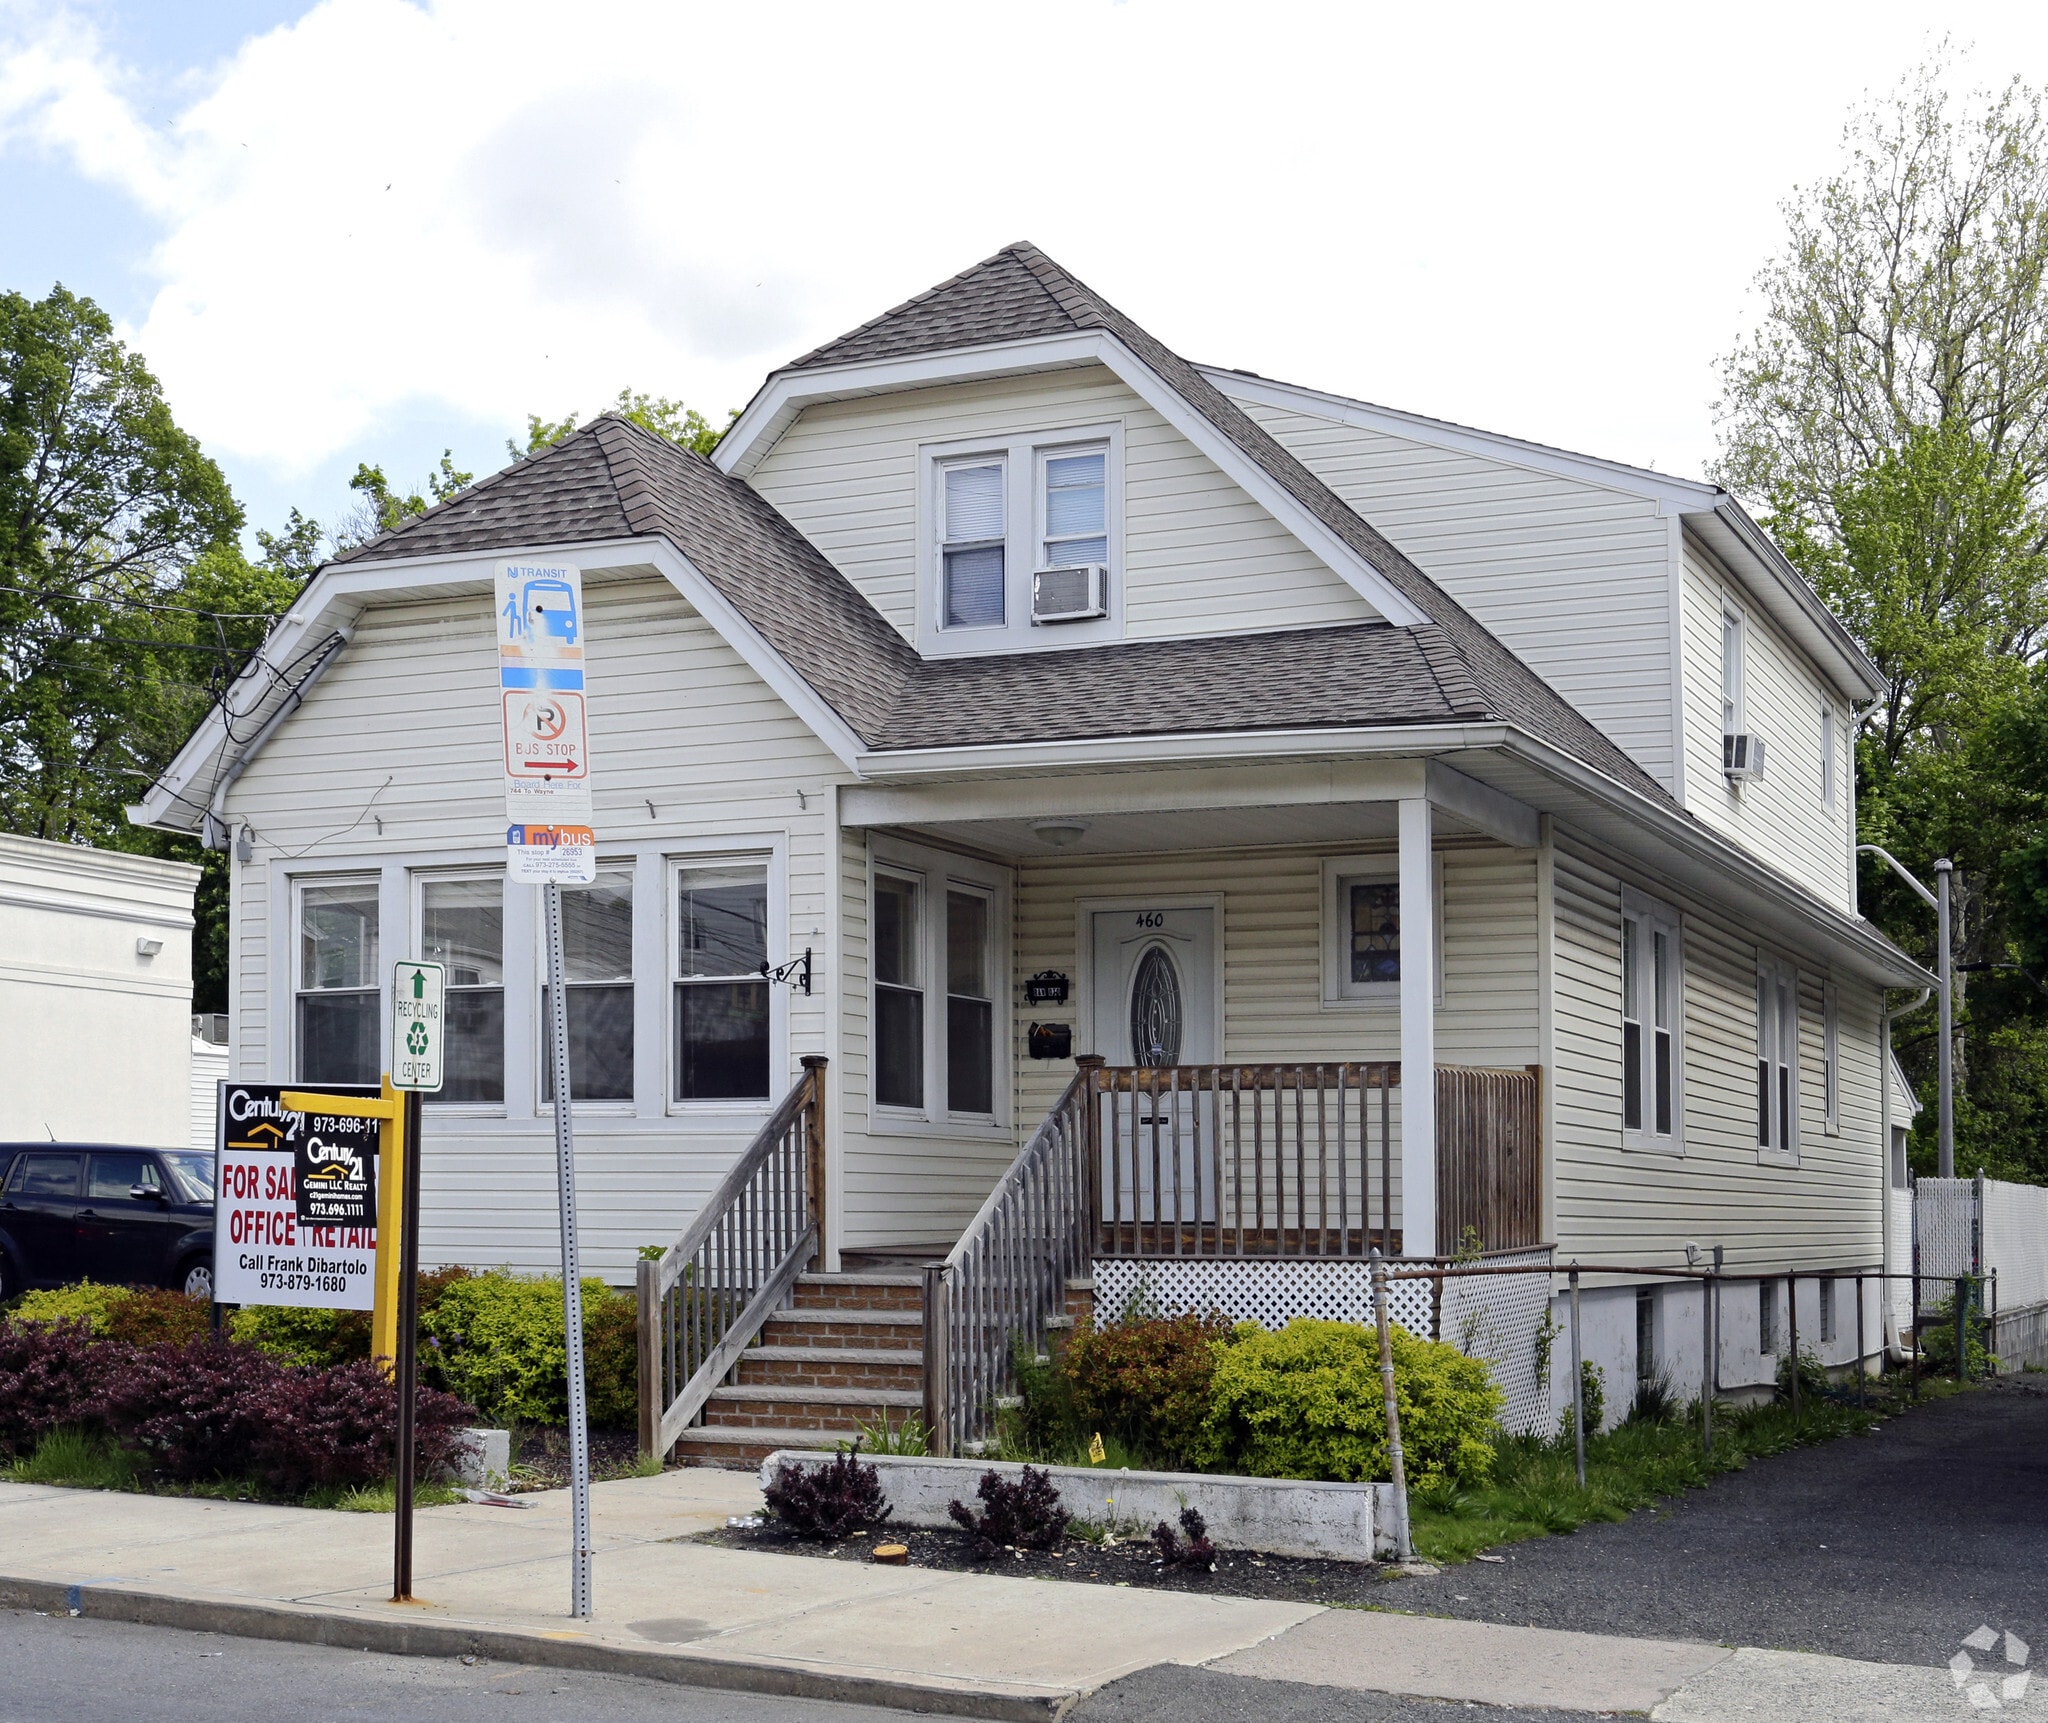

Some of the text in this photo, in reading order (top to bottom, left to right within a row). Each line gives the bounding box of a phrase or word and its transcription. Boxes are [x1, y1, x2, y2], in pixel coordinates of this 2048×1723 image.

[520, 568, 567, 578] TRANSIT
[547, 744, 576, 756] STOP
[514, 780, 540, 789] Board
[544, 781, 564, 789] Here
[533, 829, 591, 850] mybus
[1136, 912, 1164, 928] 460
[398, 1001, 438, 1019] RECYCLING
[402, 1062, 431, 1078] CENTER
[313, 1117, 381, 1134] 973-696-11
[307, 1136, 363, 1181] Century 21
[222, 1164, 297, 1201] FOR SAL
[329, 1180, 343, 1190] LLC
[309, 1191, 363, 1200] c21geminihomes.com
[310, 1202, 364, 1216] 973.696.1111
[230, 1209, 296, 1246] OFFICE
[239, 1254, 368, 1275] Call Frank Dibartolo
[260, 1273, 347, 1292] 973-879-1680
